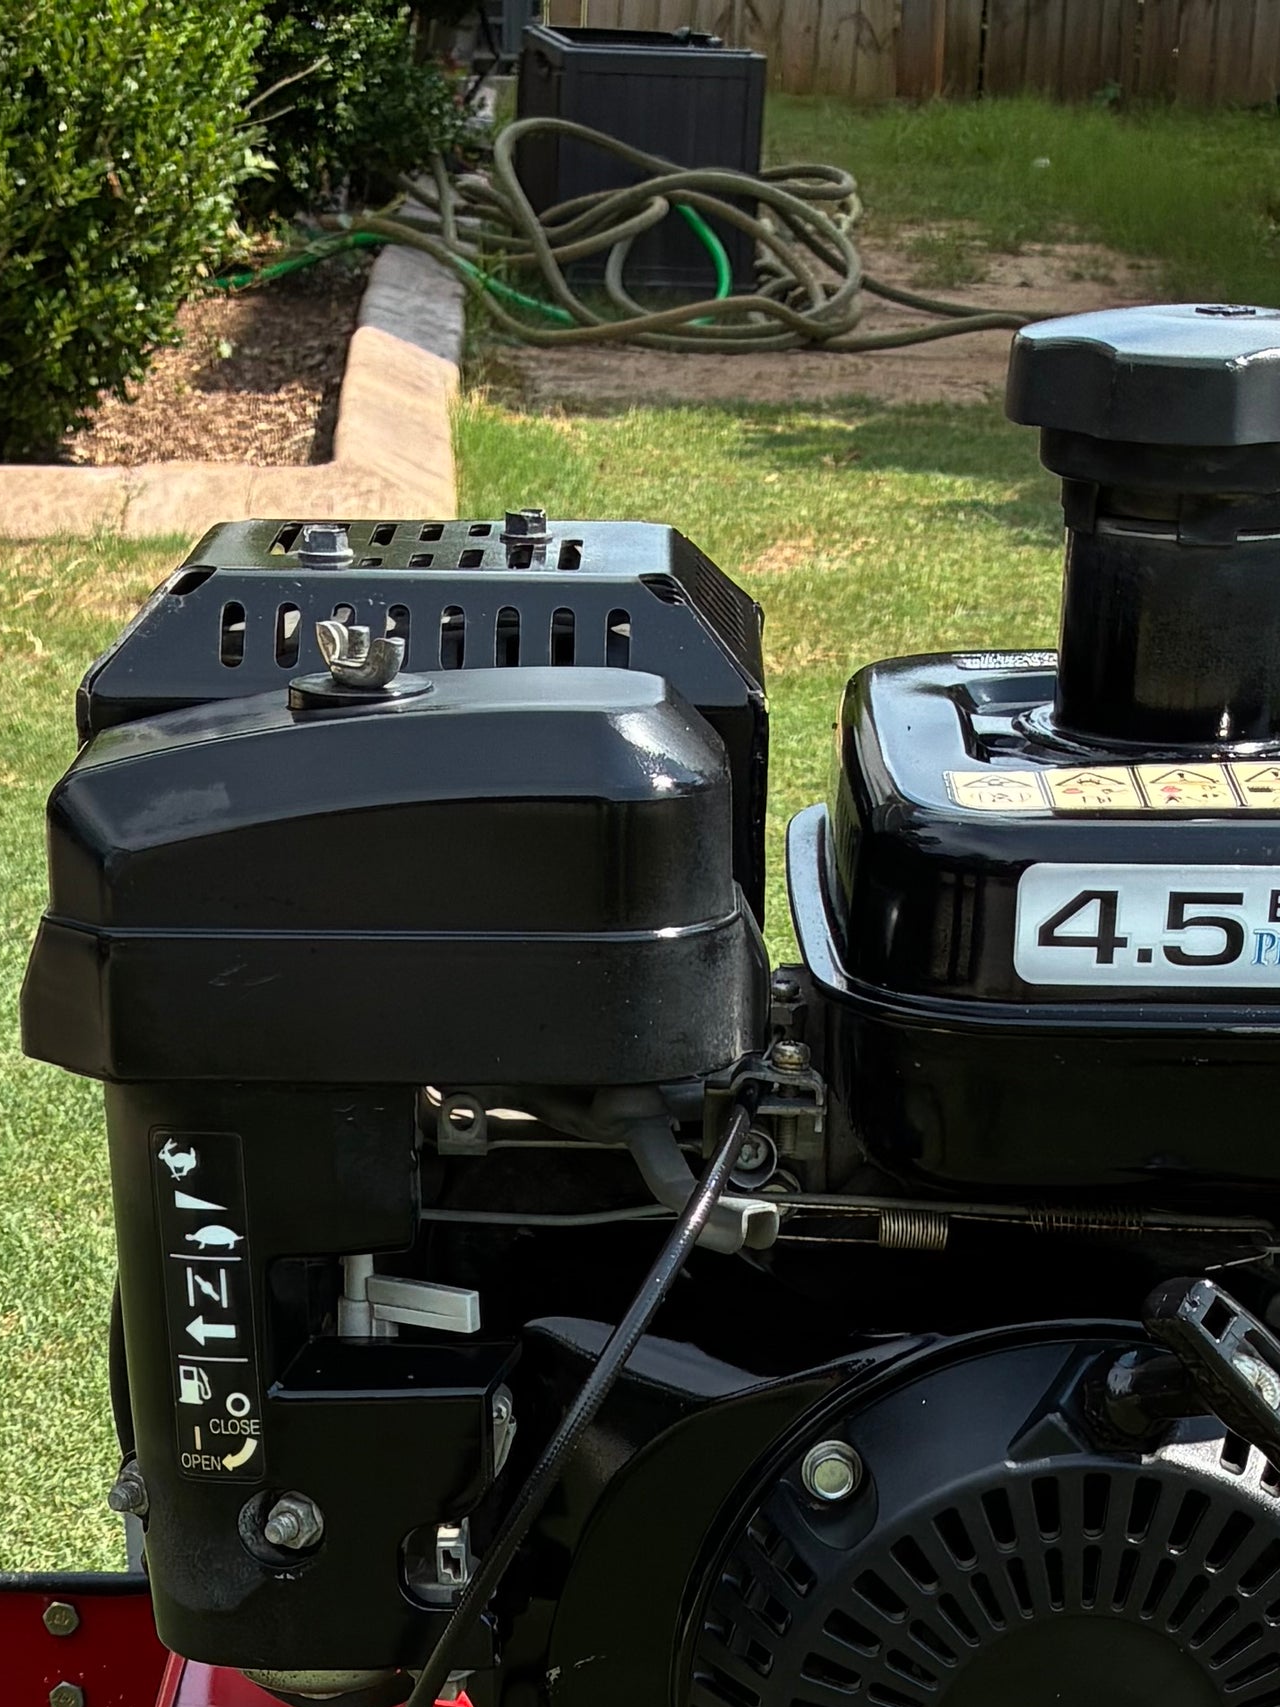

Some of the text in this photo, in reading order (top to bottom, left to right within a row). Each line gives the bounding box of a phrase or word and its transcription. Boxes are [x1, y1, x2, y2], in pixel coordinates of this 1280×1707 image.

[1037, 889, 1245, 967] 4.5
[209, 1418, 261, 1435] CLOSE
[181, 1453, 221, 1471] OPEN
